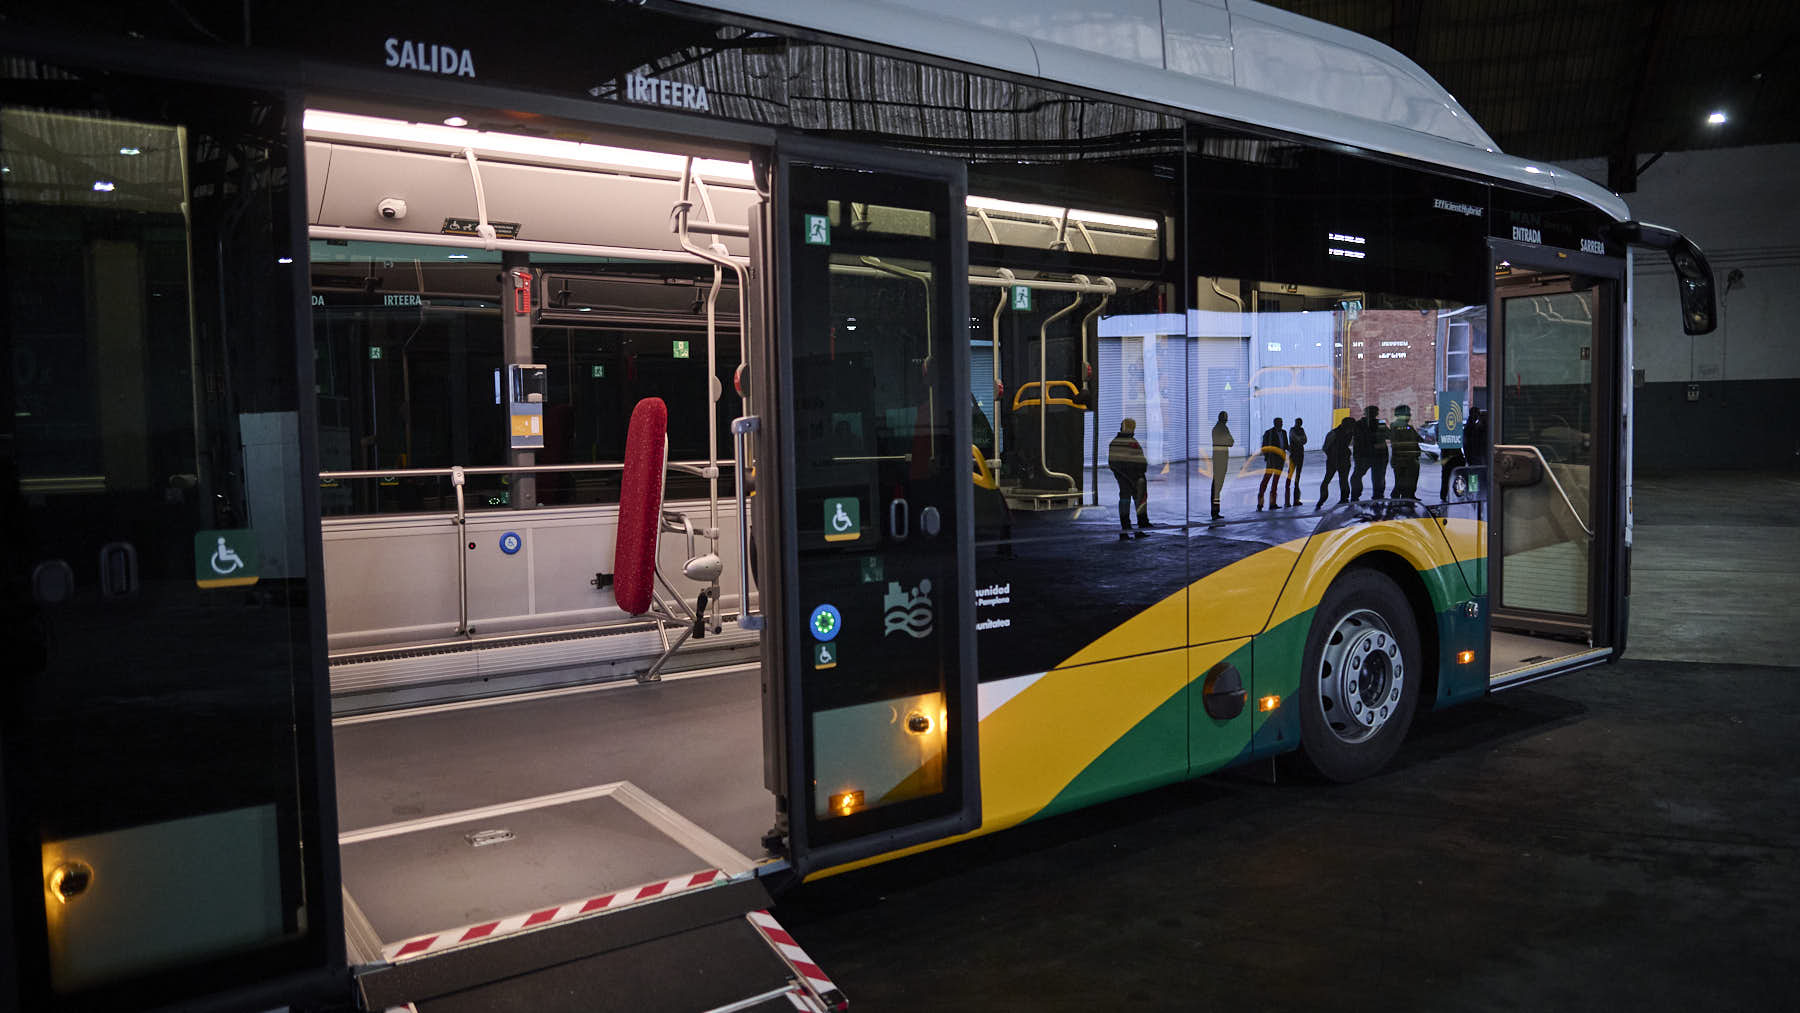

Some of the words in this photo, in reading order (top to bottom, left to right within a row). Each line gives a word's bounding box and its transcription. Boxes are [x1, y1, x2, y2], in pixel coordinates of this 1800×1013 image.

[385, 37, 476, 78] SALIDA
[626, 72, 710, 111] IRTEERA
[1512, 225, 1542, 245] ENTRADA
[1580, 238, 1605, 256] SARRERA
[384, 294, 423, 306] IRTEERA
